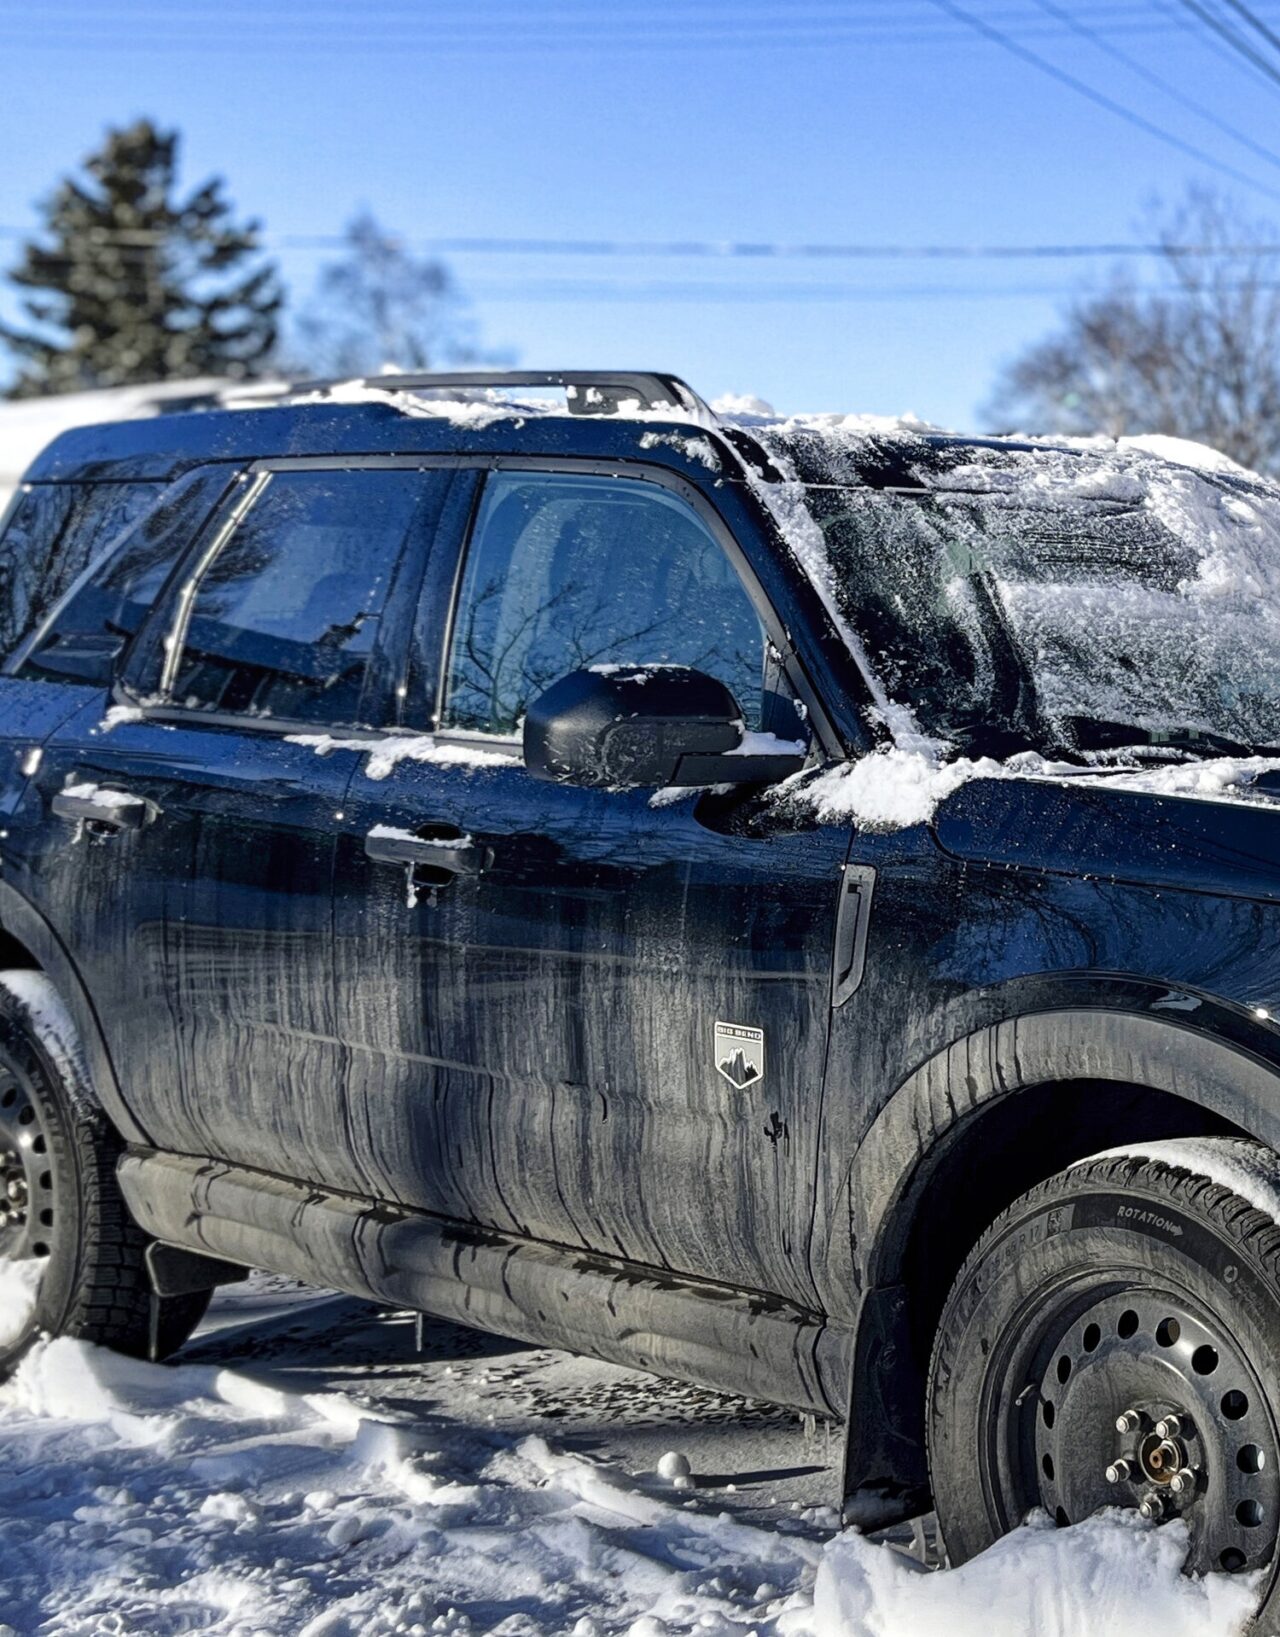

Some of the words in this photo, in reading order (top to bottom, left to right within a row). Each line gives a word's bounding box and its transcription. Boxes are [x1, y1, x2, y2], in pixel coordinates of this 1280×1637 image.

[736, 1030, 761, 1039] BEND
[30, 1071, 68, 1186] MICHEL
[1117, 1205, 1173, 1232] ROTATION
